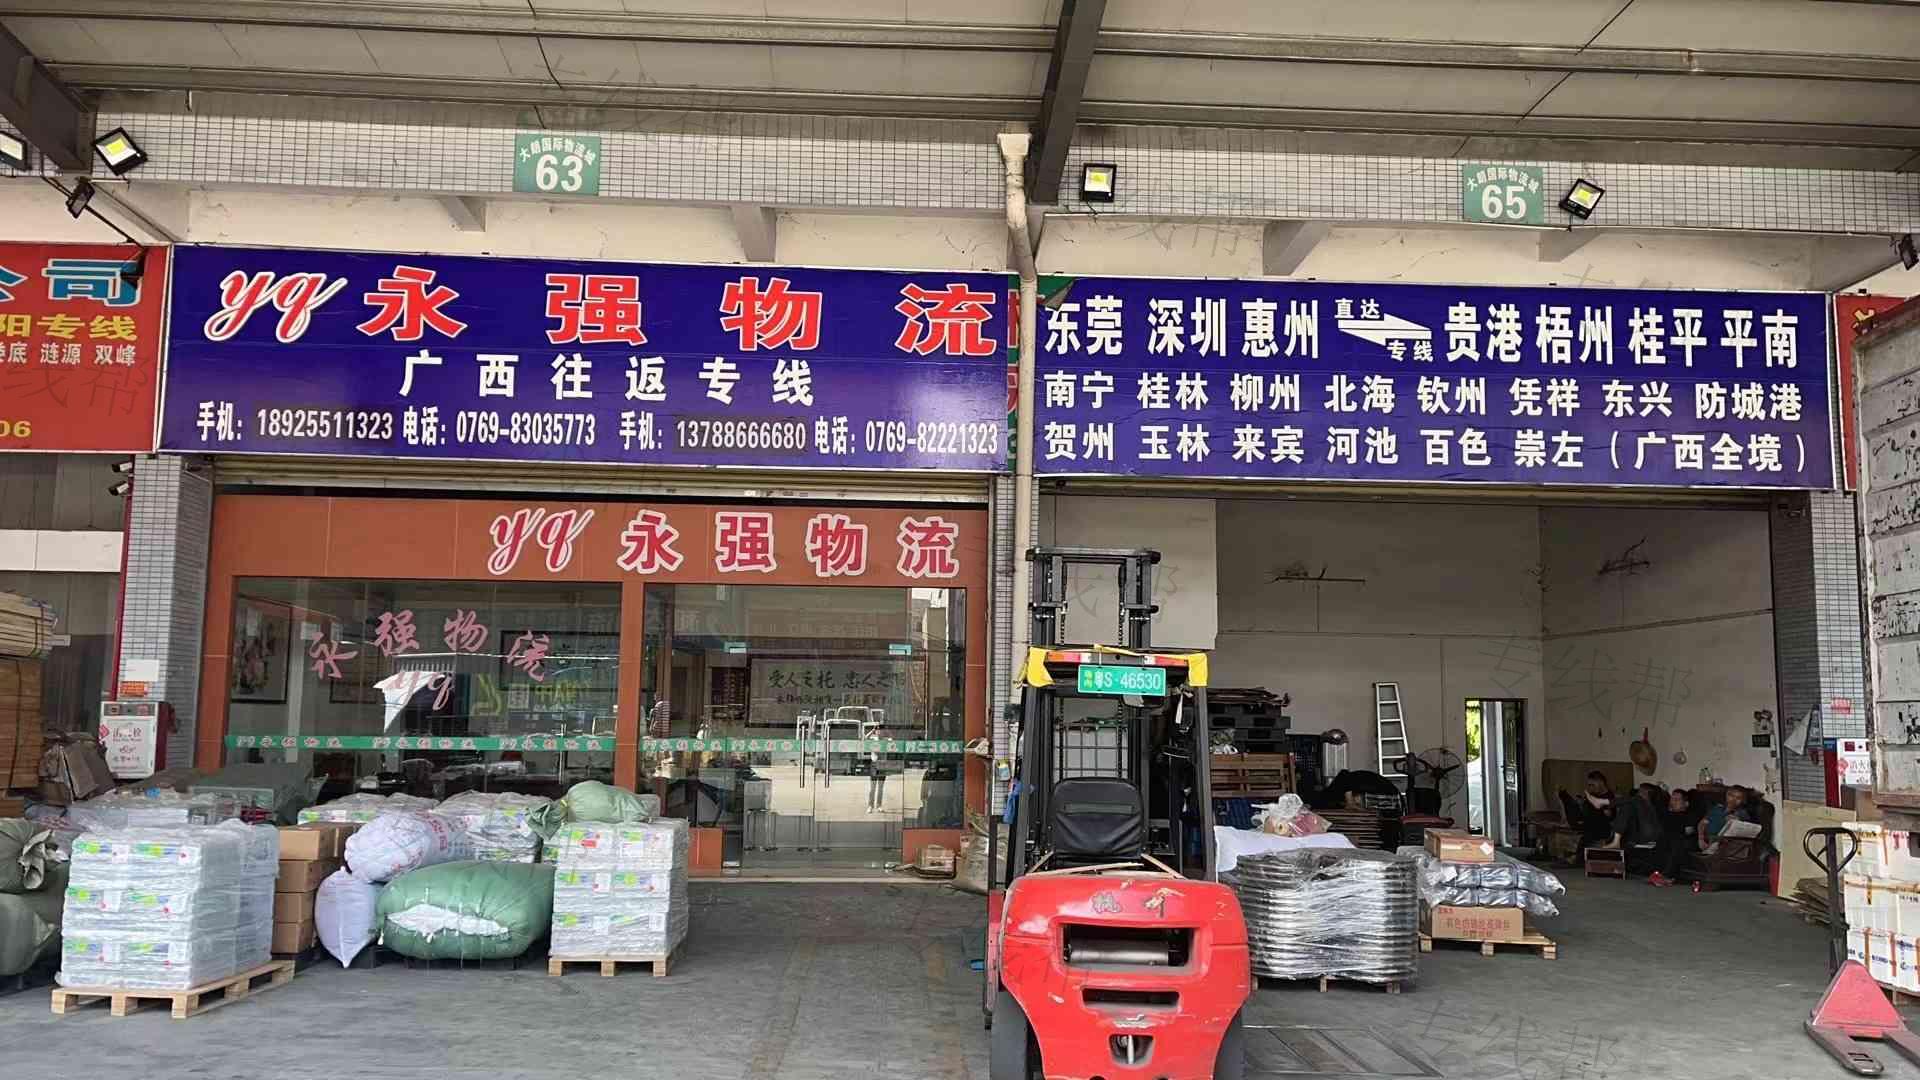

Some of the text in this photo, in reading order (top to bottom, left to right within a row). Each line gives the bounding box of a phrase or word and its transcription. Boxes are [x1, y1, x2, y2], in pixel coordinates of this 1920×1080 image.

[535, 153, 583, 192] 63
[1481, 184, 1527, 219] 65
[0, 257, 142, 307] 司
[204, 265, 997, 356] yq 永强物流
[1043, 294, 1319, 359] 东莞 深圳 惠州
[1333, 297, 1380, 319] 直达
[0, 341, 136, 366] 底 涟源 双峰
[1386, 340, 1434, 363] 专线
[1443, 301, 1799, 369] 贵港 梧州 桂平 平南
[399, 349, 814, 406] 广西往返专线
[1043, 369, 1802, 421] 南宁 桂林 柳州 北海 钦州 凭祥 东兴 防城港
[257, 408, 393, 440] 18925511323
[456, 410, 596, 448] 0769-83035773
[676, 419, 806, 450] 13788666680
[864, 420, 998, 455] 0769-82221323
[1043, 423, 1114, 462] 贺州
[1137, 423, 1211, 463] 玉林
[1231, 424, 1305, 464] 来宾
[1326, 425, 1399, 465] 河池
[1419, 427, 1492, 467] 百色
[1513, 428, 1584, 469] 崇左
[487, 508, 959, 579] yq 永强物流
[309, 608, 554, 682] 永强物流
